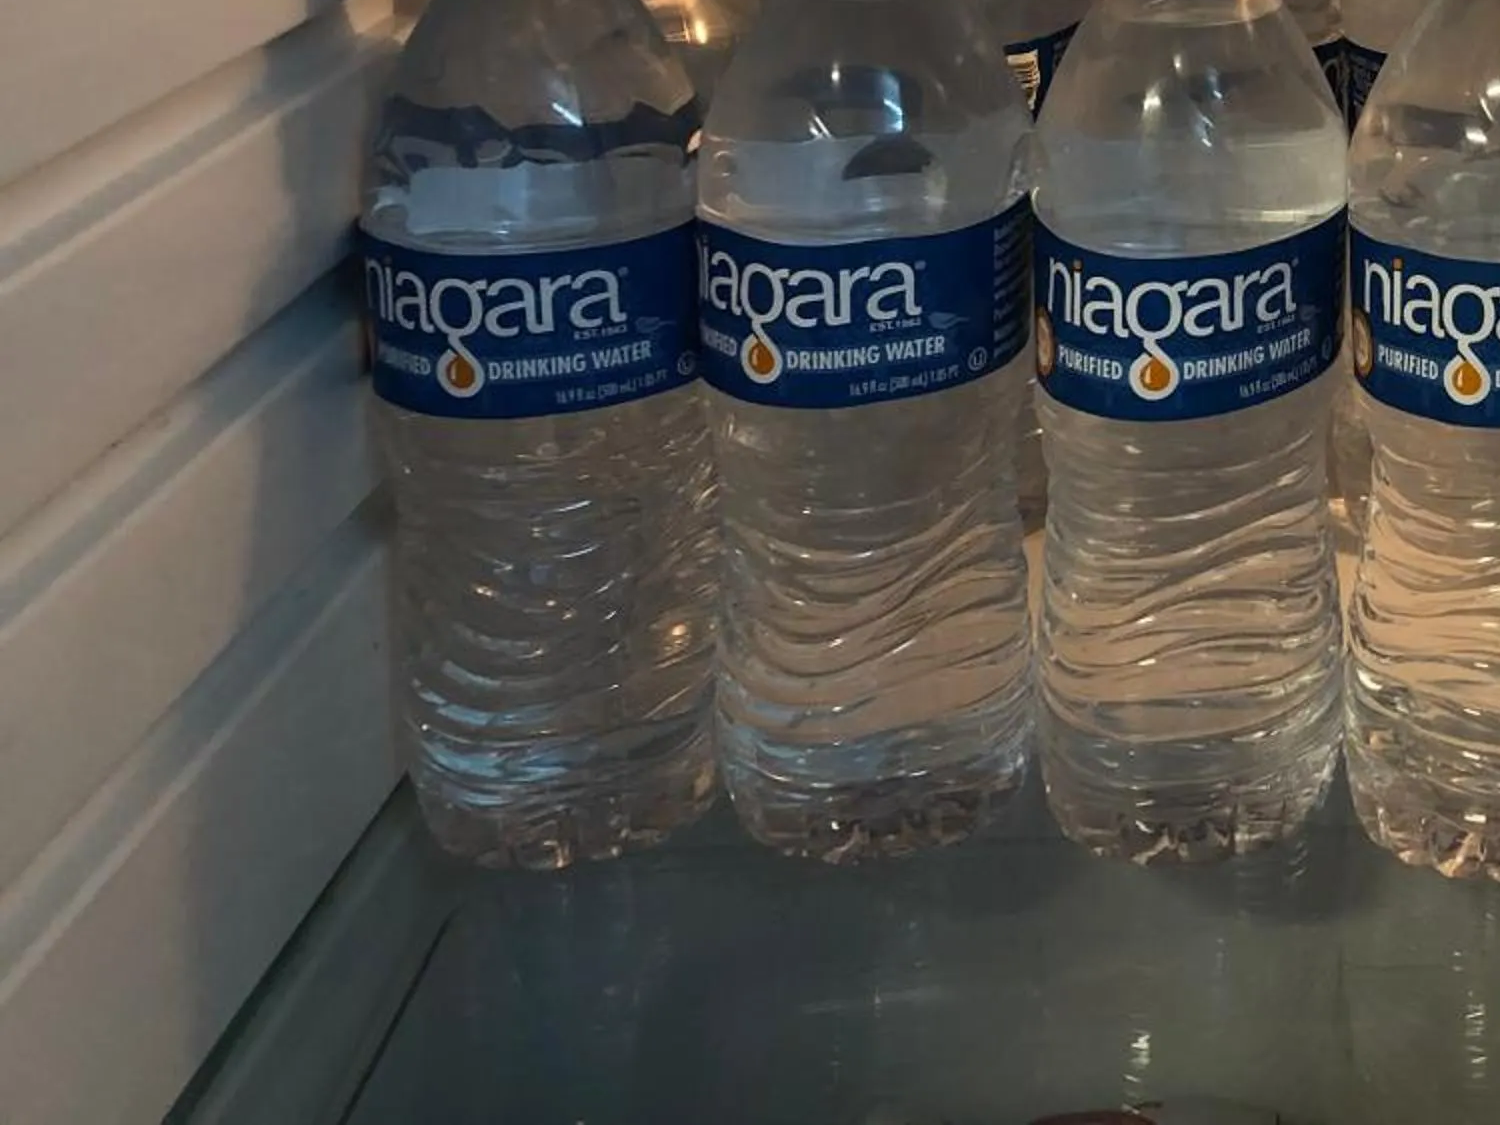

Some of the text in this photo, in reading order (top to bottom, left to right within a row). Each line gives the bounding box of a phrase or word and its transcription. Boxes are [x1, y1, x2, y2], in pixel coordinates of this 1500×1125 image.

[365, 256, 628, 351] niagara
[1049, 257, 1298, 352] niagara
[488, 351, 586, 381] DRINKING
[591, 339, 653, 370] WATER
[785, 343, 880, 371] DRINKING
[886, 335, 945, 362] WATER
[1058, 343, 1123, 380] PURIFIED
[1183, 342, 1265, 380] DRINKING
[1269, 327, 1312, 361] WATER
[1377, 344, 1439, 380] PURIFIED
